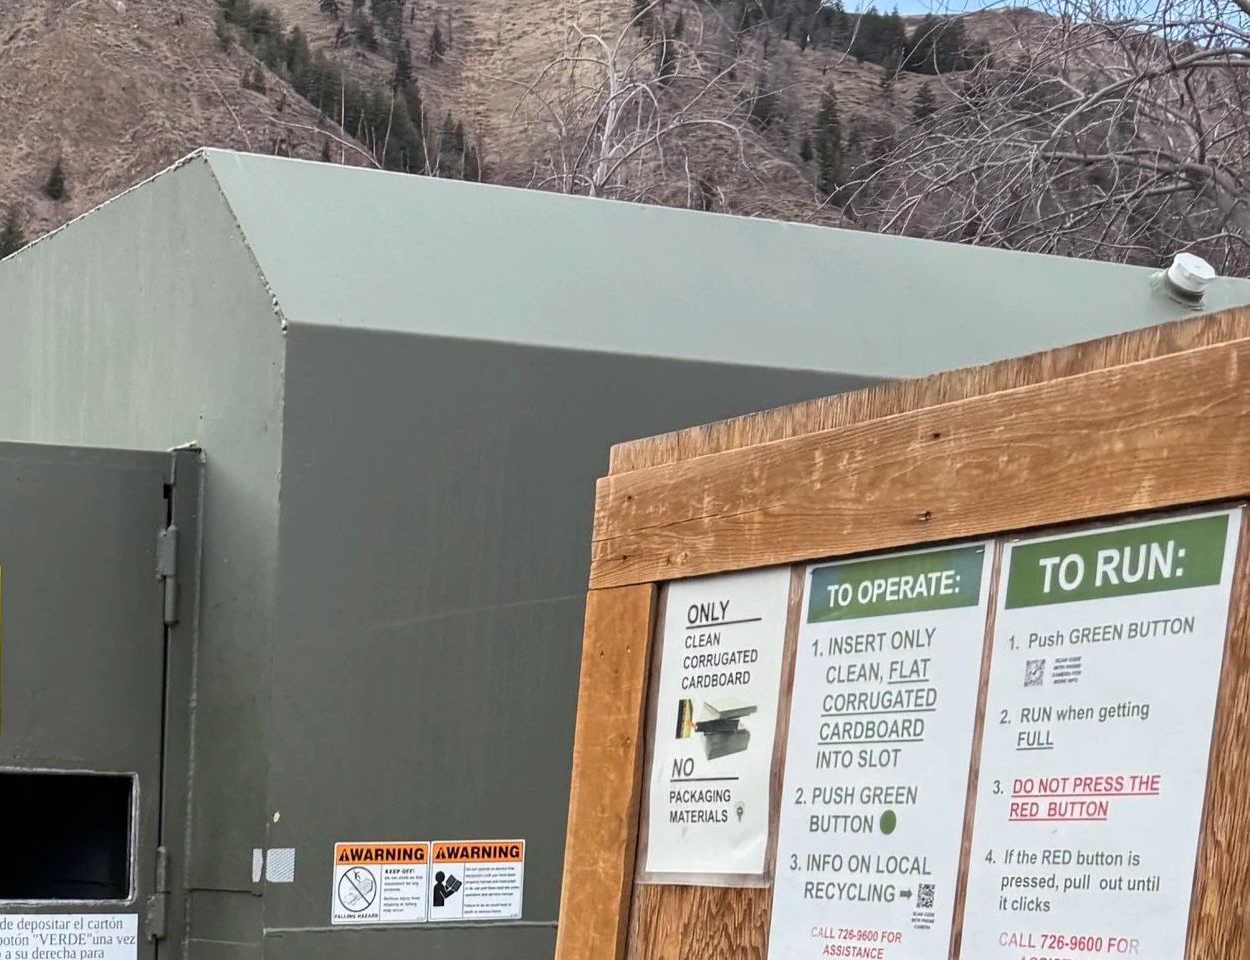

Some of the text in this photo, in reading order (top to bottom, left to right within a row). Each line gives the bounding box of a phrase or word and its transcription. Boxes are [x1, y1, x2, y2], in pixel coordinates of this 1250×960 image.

[1039, 540, 1186, 593] TO RUN:
[827, 570, 960, 607] TO OPERATE:
[687, 600, 729, 624] ONLY
[685, 632, 721, 649] CLEAN
[812, 627, 937, 657] 1. INSERT ONLY
[1008, 616, 1195, 651] 1. Push GREEN BUTTON
[683, 649, 758, 669] CORRUGATED
[681, 671, 750, 690] CARDBOARD
[826, 658, 929, 685] CLEAN, FLAT
[823, 688, 937, 712] CORRUGATED
[1000, 701, 1150, 724] 2. RUN when getting
[819, 718, 925, 741] CARDBOARD
[1017, 730, 1054, 747] FULL
[672, 758, 694, 778] NO
[816, 748, 902, 769] INTO SLOT
[993, 775, 1161, 794] 3. DO NOT PRESS THE
[670, 789, 731, 804] PACKAGING
[795, 786, 918, 805] 2. PUSH GREEN
[670, 810, 728, 823] MATERIALS
[1010, 801, 1109, 817] RED BUTTON
[809, 815, 874, 833] BUTTON
[350, 848, 424, 861] WARNING
[446, 846, 520, 859] WARNING
[985, 849, 1140, 866] 4. If the RED button is
[790, 854, 932, 875] 3. INFO ON LOCAL
[804, 881, 896, 903] RECYCLING
[1001, 874, 1160, 893] pressed, pull out until
[999, 896, 1051, 912] it clicks
[0, 919, 13, 930] de
[17, 919, 71, 932] depositar
[74, 917, 83, 930] el
[87, 916, 123, 929] cartón
[117, 935, 135, 946] vez
[811, 927, 902, 943] CALL 726-9600 FOR
[999, 932, 1139, 955] CALL 726-9600 FOR
[5, 951, 11, 959] a
[15, 950, 28, 960] su
[32, 947, 76, 959] derecha
[823, 944, 884, 959] ASSISTANCE
